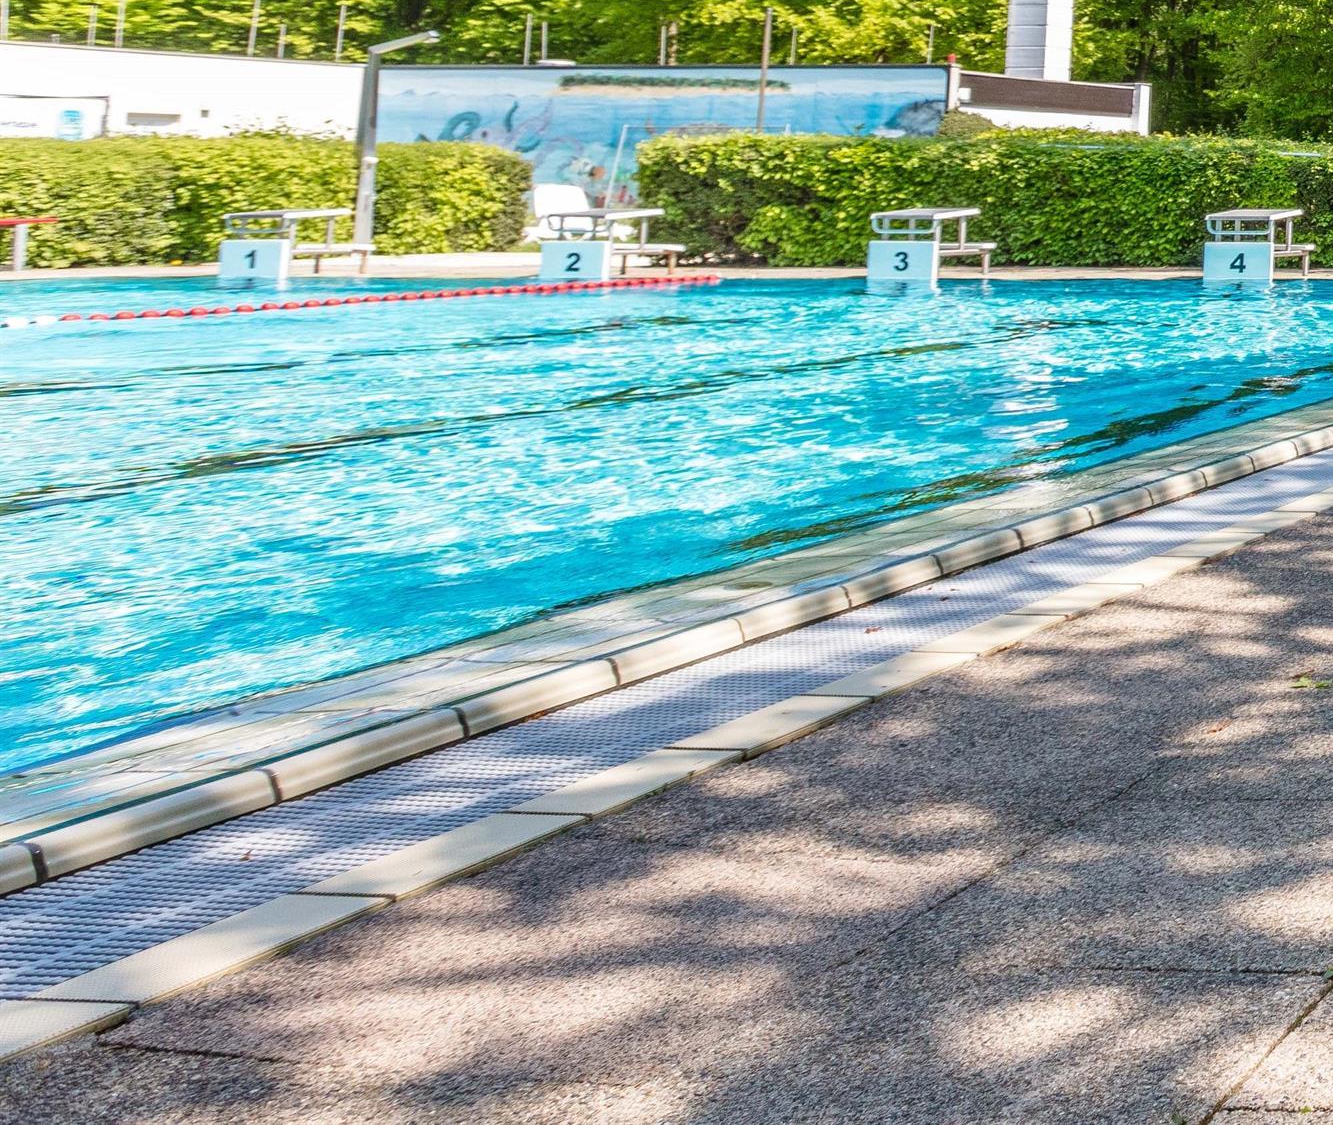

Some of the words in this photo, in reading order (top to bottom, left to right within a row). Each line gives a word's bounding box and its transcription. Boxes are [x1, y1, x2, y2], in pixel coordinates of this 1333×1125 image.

[244, 249, 258, 269] 1
[564, 252, 581, 272] 2
[893, 251, 909, 272] 3
[1229, 252, 1247, 274] 4
